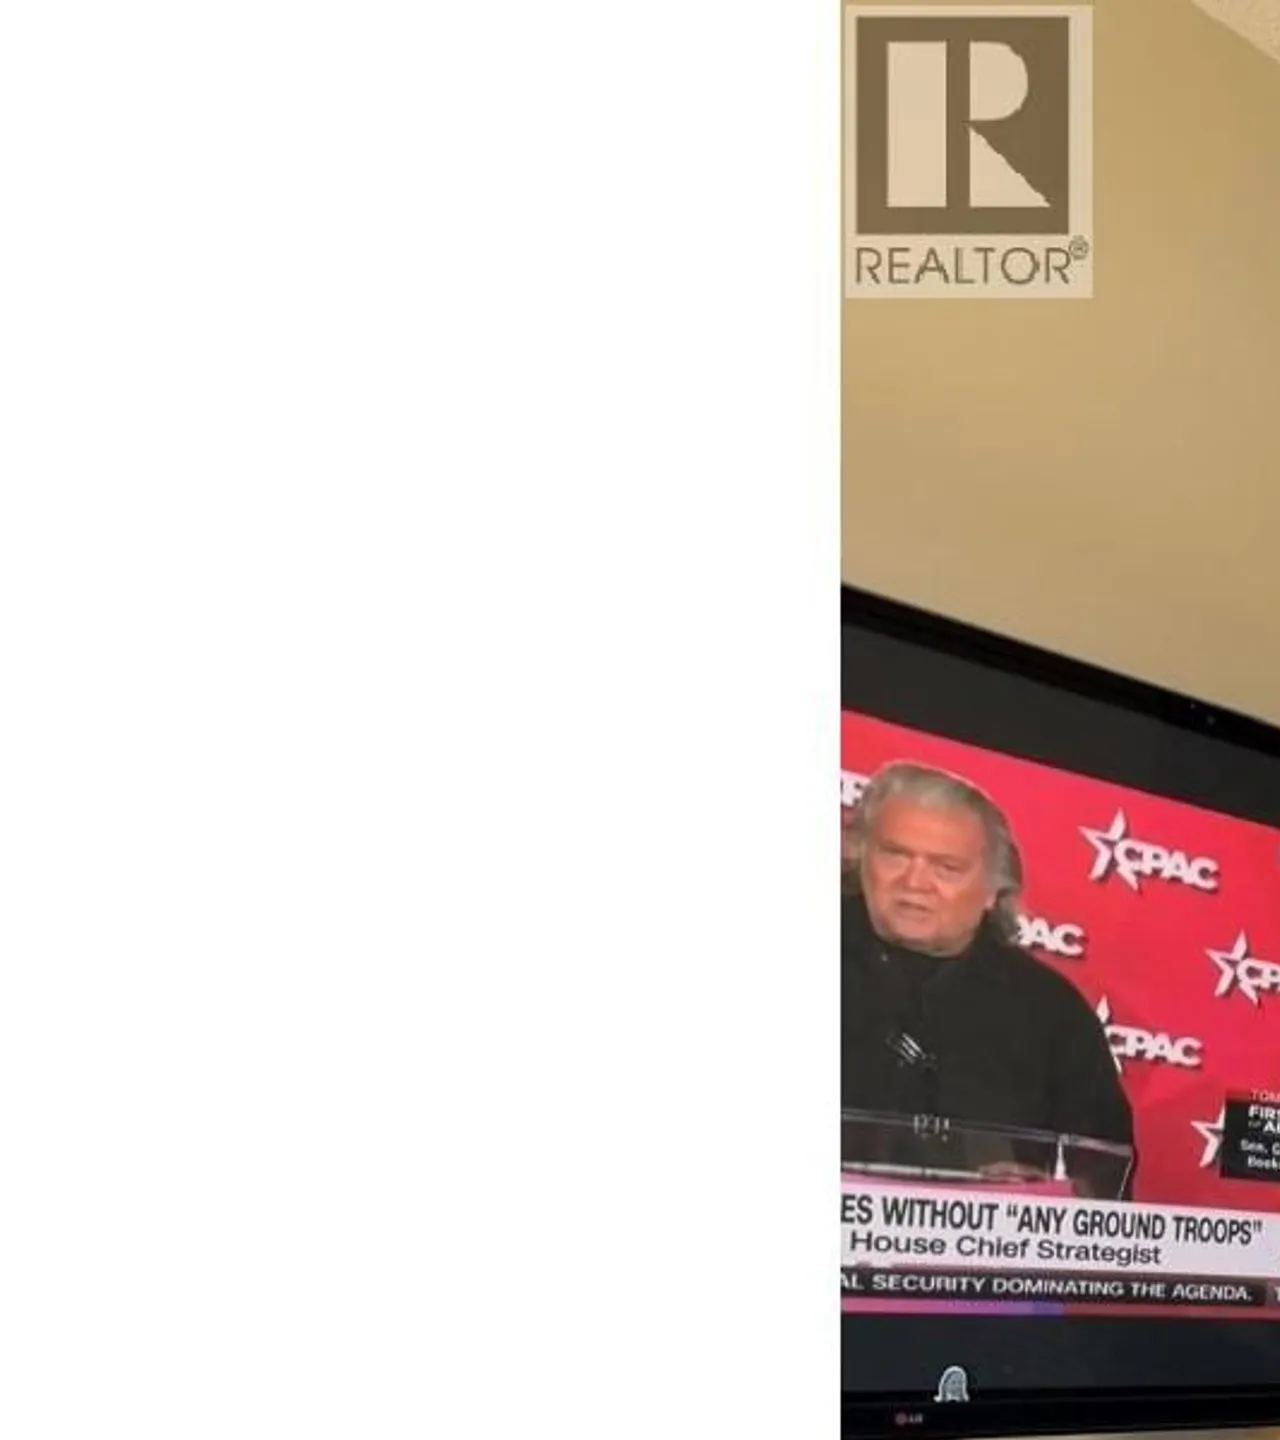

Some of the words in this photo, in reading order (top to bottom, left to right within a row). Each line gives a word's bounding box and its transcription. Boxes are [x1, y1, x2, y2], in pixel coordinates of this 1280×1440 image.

[1114, 838, 1219, 890] CPAC
[882, 1196, 999, 1231] WITHOUT
[1073, 1209, 1166, 1240] GROUND
[850, 1230, 947, 1255] House
[956, 1236, 1031, 1259] Chief
[1037, 1239, 1162, 1266] Strategist
[872, 1274, 987, 1293] SECURITY
[992, 1276, 1125, 1297] DOMINATING
[1130, 1282, 1166, 1298] THE
